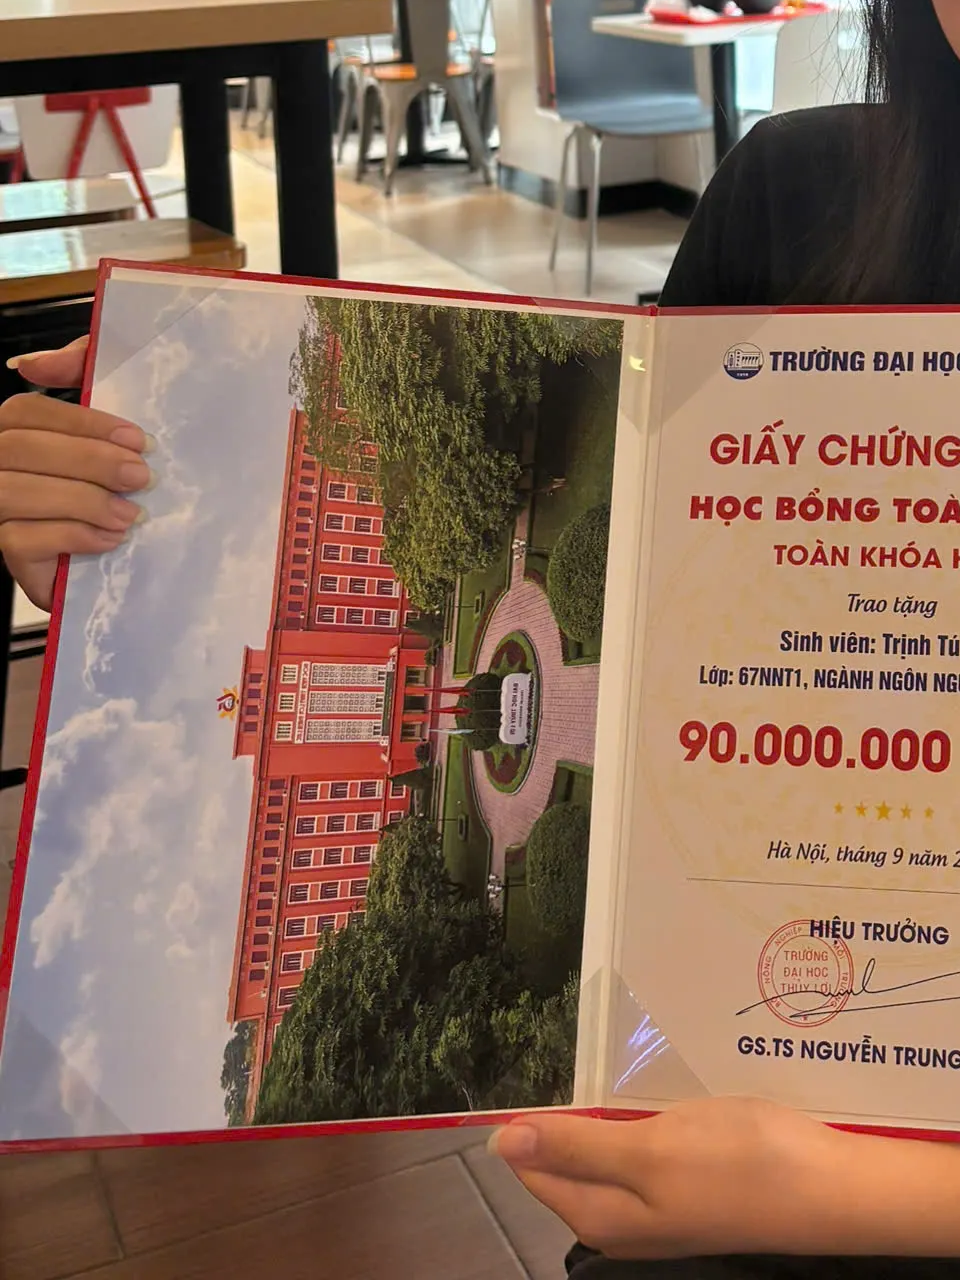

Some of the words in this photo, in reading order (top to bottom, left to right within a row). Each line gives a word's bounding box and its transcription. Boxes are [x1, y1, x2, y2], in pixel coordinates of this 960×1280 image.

[770, 346, 865, 371] TRƯỜNG
[873, 352, 913, 376] ĐẠI
[710, 420, 805, 465] GIẤY
[690, 496, 762, 526] HỌC
[776, 488, 880, 522] BỔNG
[774, 539, 849, 566] TOÀN
[861, 541, 942, 568] KHÓA
[848, 594, 887, 612] Trao
[894, 596, 937, 618] tặng
[780, 631, 822, 652] Sinh
[830, 633, 875, 653] viên:
[883, 633, 930, 659] Trịnh
[938, 635, 959, 656] Tú
[700, 665, 733, 687] Lớp:
[739, 667, 808, 690] 67NNT1,
[814, 666, 873, 689] NGÀNH
[879, 668, 927, 691] NGÔN
[679, 721, 950, 772] 90.000.000
[767, 840, 791, 859] Hà
[796, 843, 829, 864] Nội,
[837, 846, 887, 867] tháng
[893, 848, 903, 864] 9
[909, 850, 947, 866] năm
[810, 916, 855, 945] HIỆU
[862, 918, 949, 945] TRƯỞNG
[738, 1036, 793, 1057] GS.TS
[801, 1035, 886, 1064] NGUYỄN
